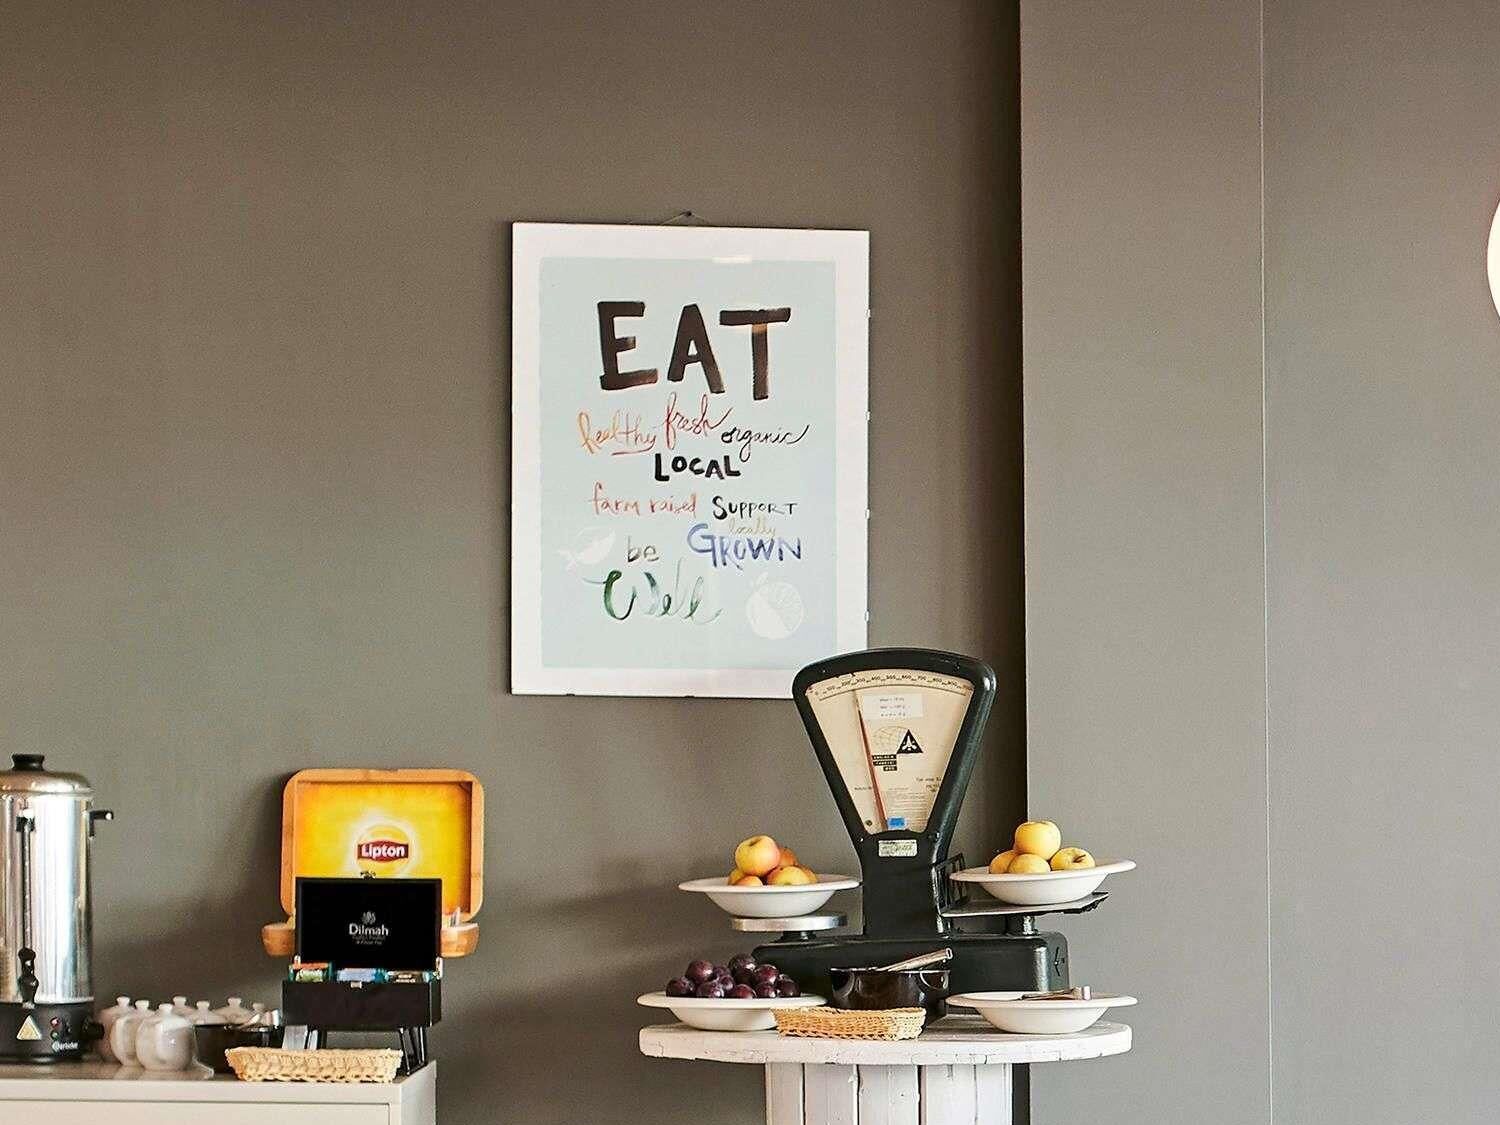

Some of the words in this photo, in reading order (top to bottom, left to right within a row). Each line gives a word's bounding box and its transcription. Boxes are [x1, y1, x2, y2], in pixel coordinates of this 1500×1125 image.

[597, 301, 791, 400] EAT
[577, 411, 657, 455] healthy
[664, 392, 733, 450] fresh
[721, 424, 809, 462] organic
[654, 453, 741, 482] LOCAL
[591, 482, 641, 516] farm
[650, 492, 698, 518] raised
[627, 536, 660, 563] be
[687, 523, 802, 571] GROWN
[361, 843, 406, 859] Lipton
[349, 923, 389, 936] Dilmah
